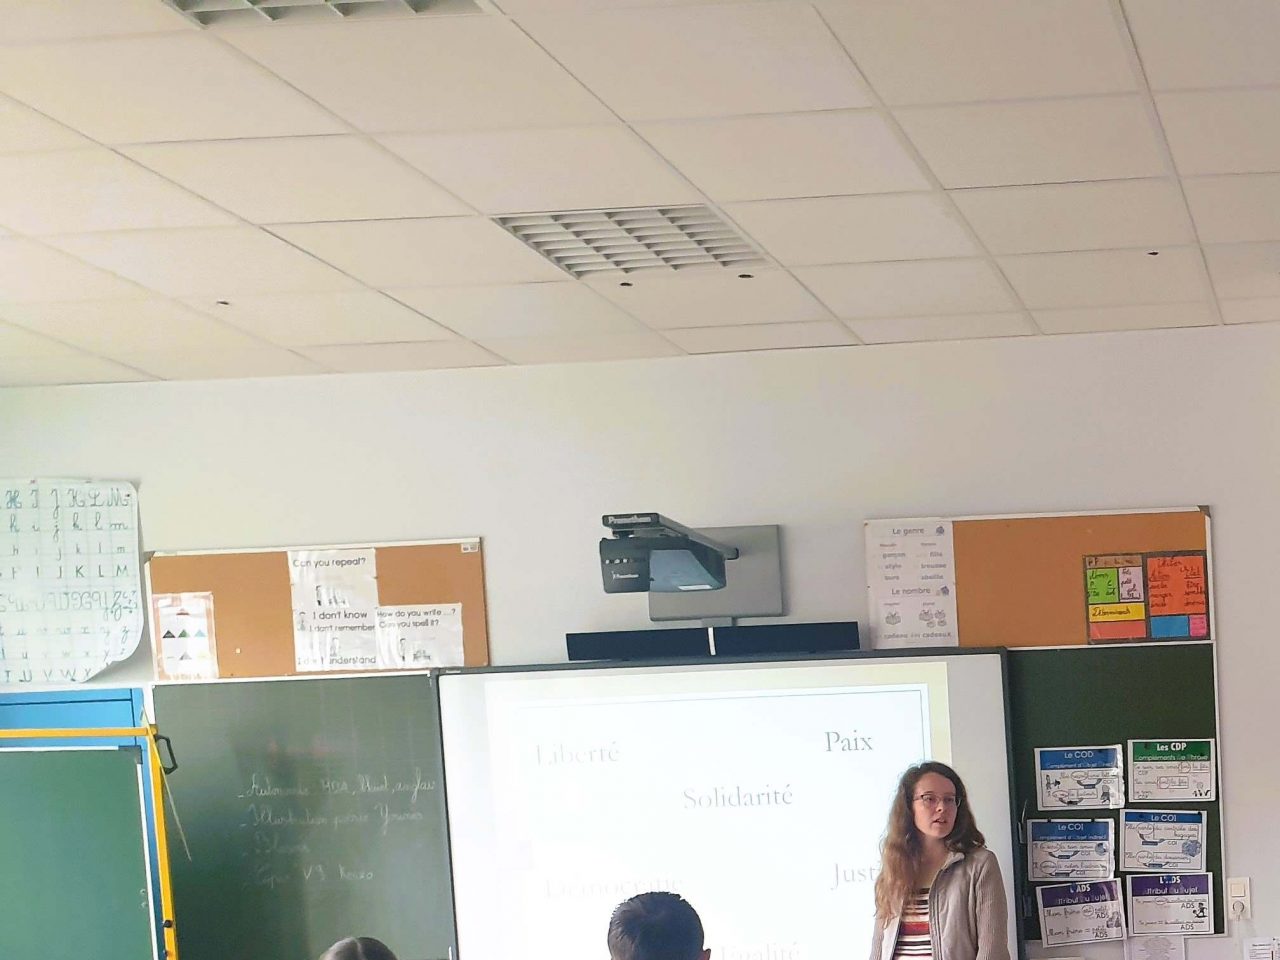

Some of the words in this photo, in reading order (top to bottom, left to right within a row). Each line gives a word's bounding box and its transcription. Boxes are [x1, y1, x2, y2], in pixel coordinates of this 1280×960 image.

[903, 528, 925, 537] genre
[314, 558, 330, 570] you
[332, 557, 367, 569] repeat?
[902, 586, 931, 595] nombre
[343, 610, 368, 620] know
[395, 609, 406, 617] do
[407, 610, 422, 618] you
[423, 608, 442, 616] write
[334, 623, 375, 632] remember
[412, 618, 429, 628] spell
[825, 729, 874, 752] Paix
[1157, 743, 1168, 751] Les
[1170, 742, 1187, 751] CDP
[535, 741, 620, 766] Liberté
[1075, 751, 1094, 759] COD
[683, 784, 794, 810] Solidarité
[1160, 814, 1177, 822] COI
[1067, 823, 1084, 831] COI
